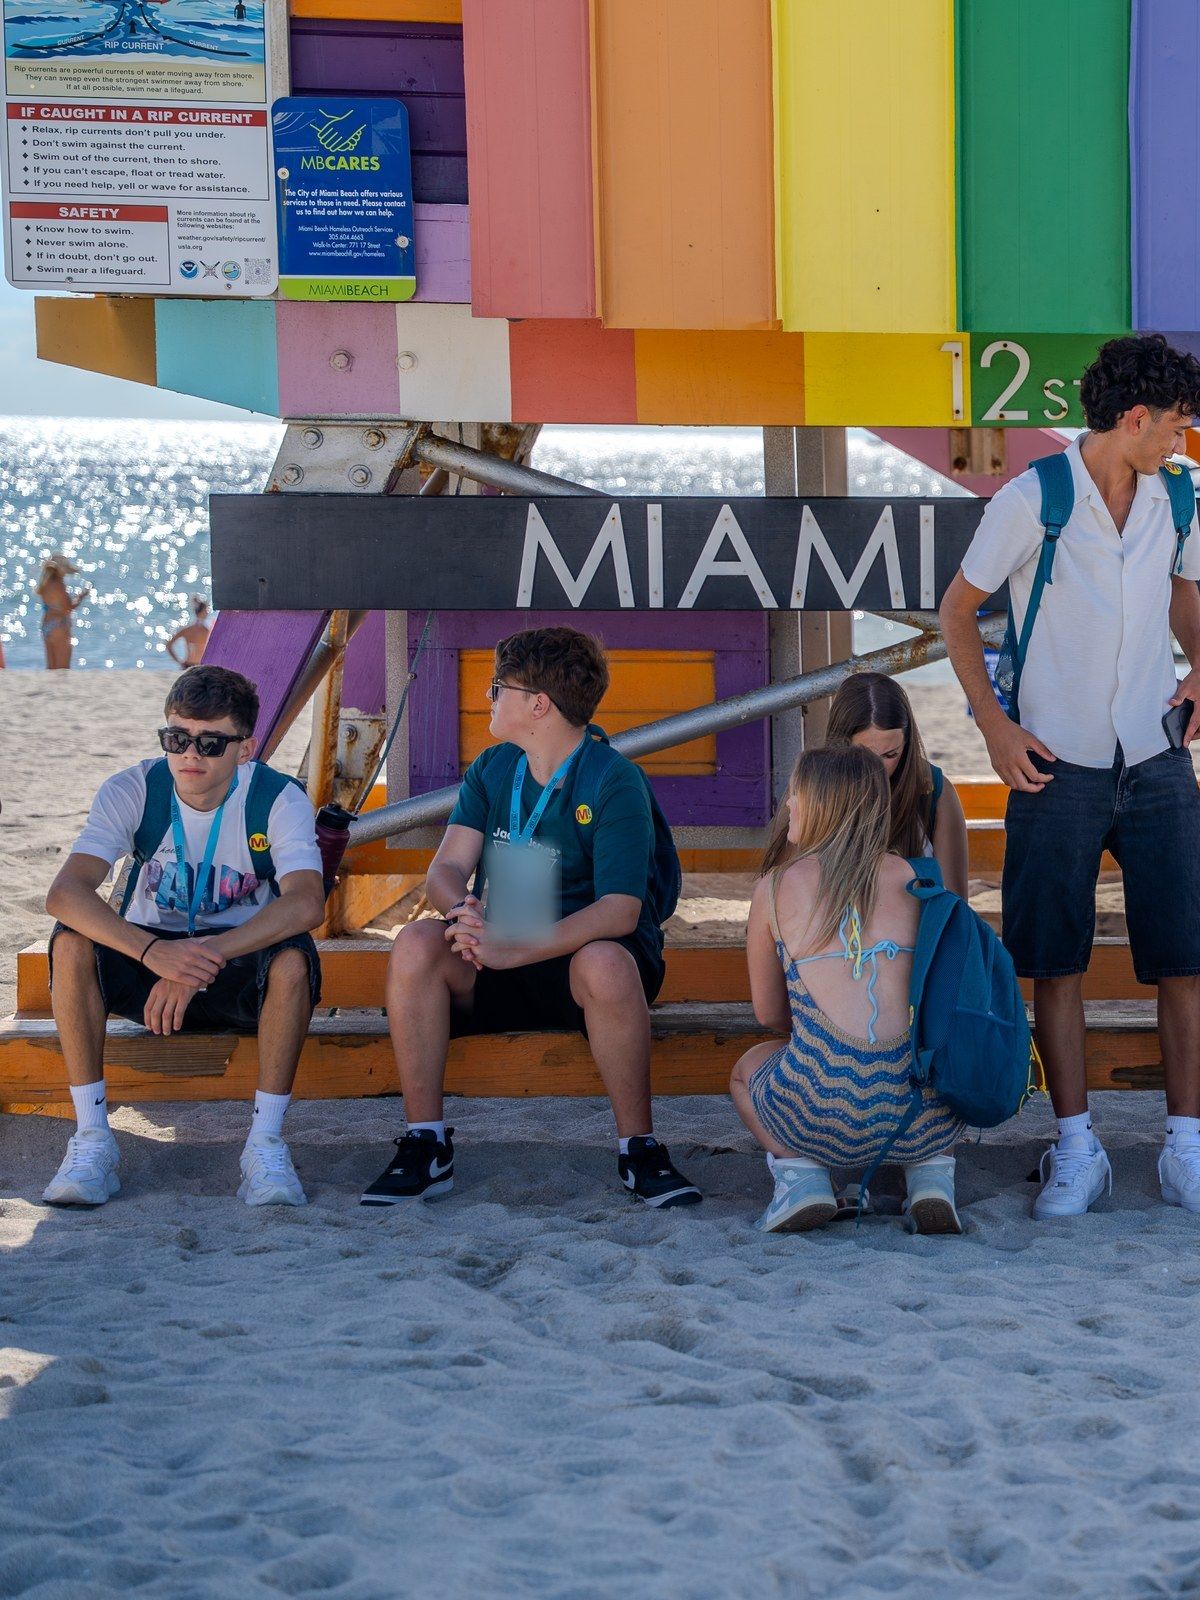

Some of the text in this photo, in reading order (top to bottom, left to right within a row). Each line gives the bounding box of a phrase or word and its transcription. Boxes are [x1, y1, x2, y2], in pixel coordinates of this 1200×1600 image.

[57, 35, 85, 46] CURRENT
[104, 41, 164, 50] RIP CURRENT
[188, 39, 218, 50] CURRENT
[72, 67, 104, 75] powerful
[21, 107, 253, 124] IF CAUGHT IN A RIP CURRENT
[32, 126, 62, 134] Relax,
[65, 127, 78, 135] rip
[153, 130, 171, 138] pull
[90, 142, 126, 150] against
[300, 156, 380, 171] MBCARES
[91, 182, 115, 190] help,
[118, 182, 135, 191] yell
[297, 189, 310, 198] City
[59, 207, 120, 219] SAFETY
[100, 267, 146, 276] lifeguard.
[309, 285, 389, 296] MIAMIBEACH
[940, 341, 1081, 421] 12 S
[515, 503, 934, 608] MIAMI
